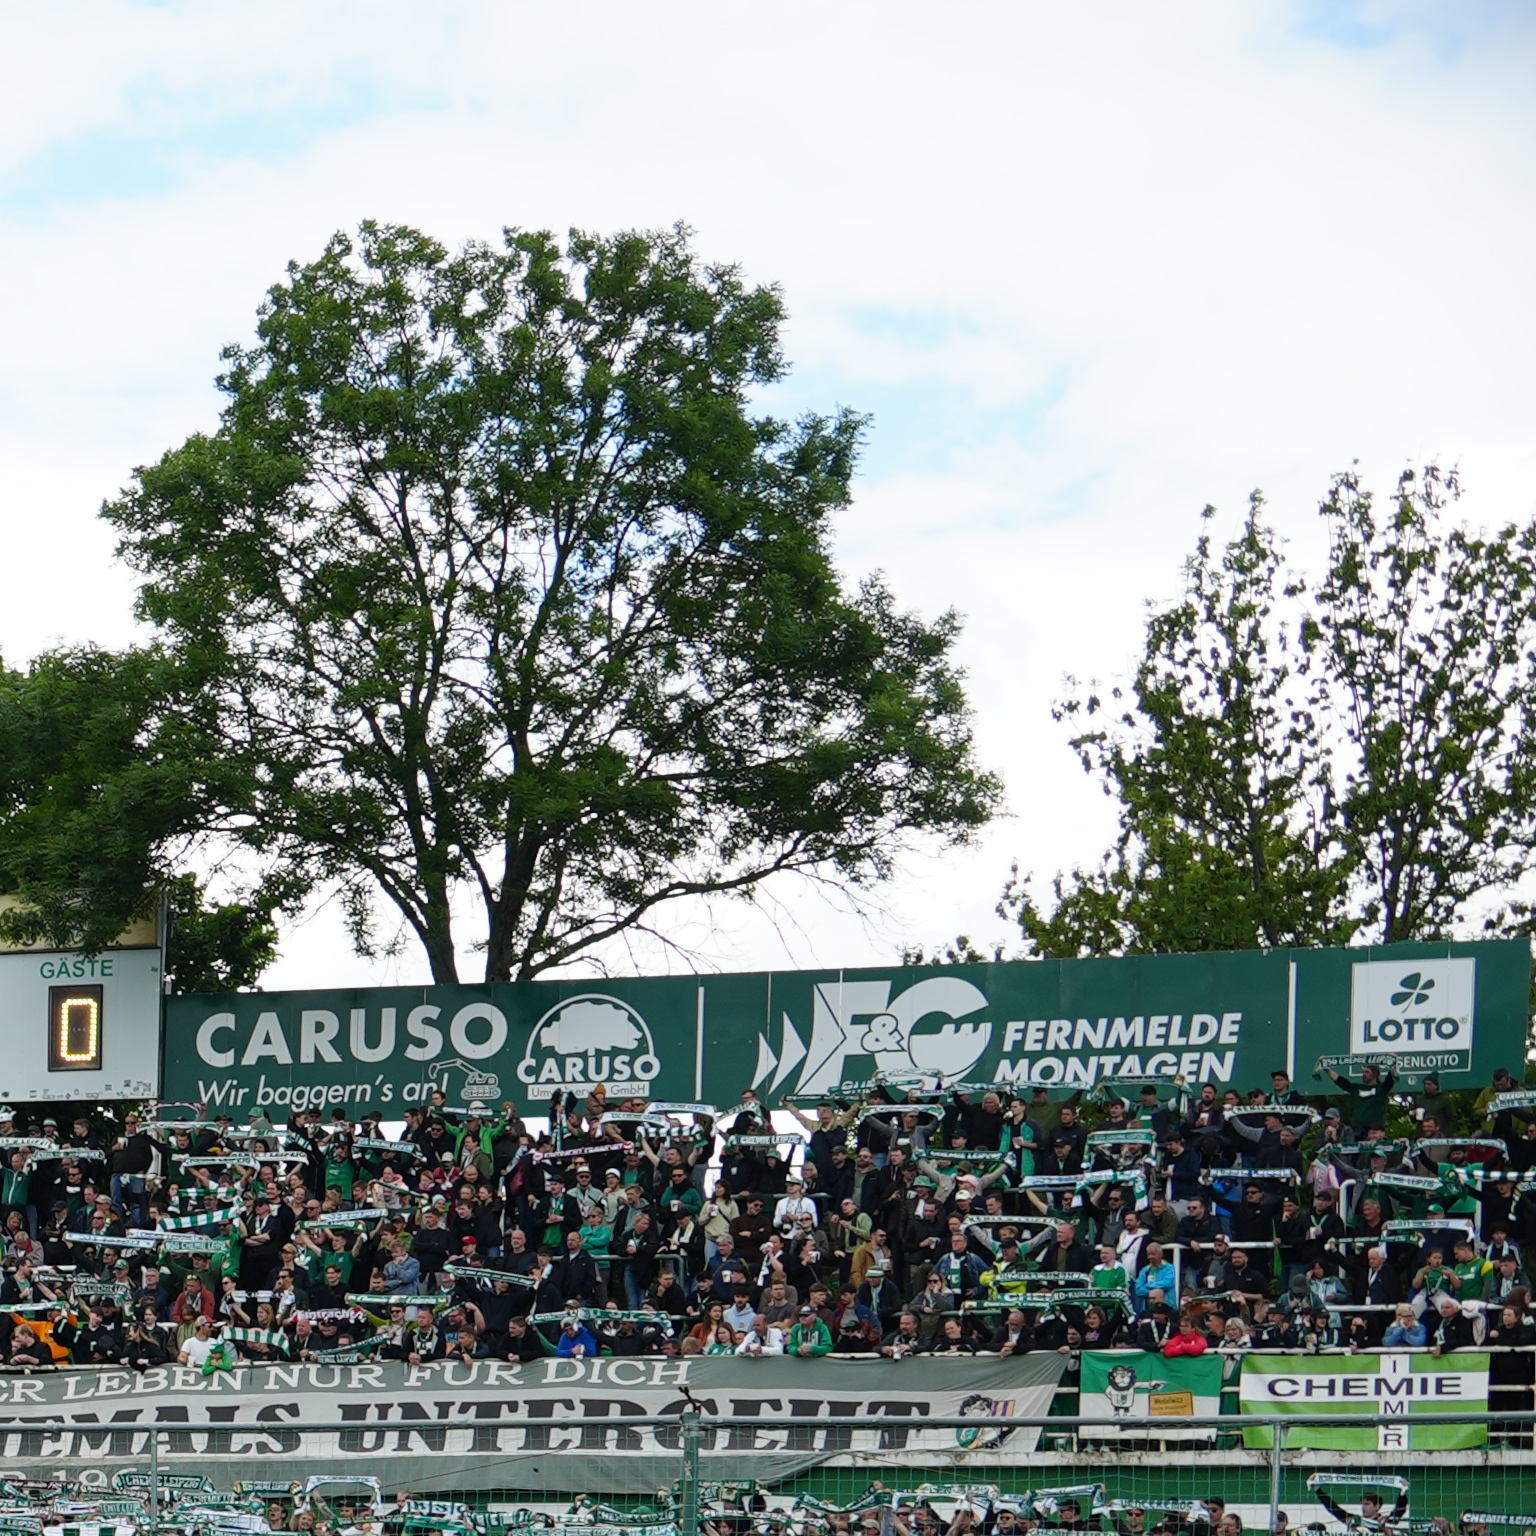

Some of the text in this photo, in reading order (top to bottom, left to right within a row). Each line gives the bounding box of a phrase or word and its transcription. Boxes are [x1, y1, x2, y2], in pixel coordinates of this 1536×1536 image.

[40, 957, 114, 981] GÄSTE
[60, 998, 98, 1062] 0
[195, 1003, 508, 1066] CARUSO
[1003, 1012, 1242, 1052] FERNMELDE
[1362, 1016, 1458, 1043] LOTTO
[516, 1054, 661, 1084] CARUSO
[995, 1051, 1237, 1096] MONTAGEN
[198, 1078, 249, 1105] Wir
[611, 1083, 646, 1096] GmbH
[64, 1361, 246, 1401] LEBEN
[264, 1361, 386, 1391] NUR
[541, 1358, 692, 1388] DICH
[1267, 1375, 1464, 1399] CHEMIE
[1463, 1512, 1508, 1525] CHEMIE
